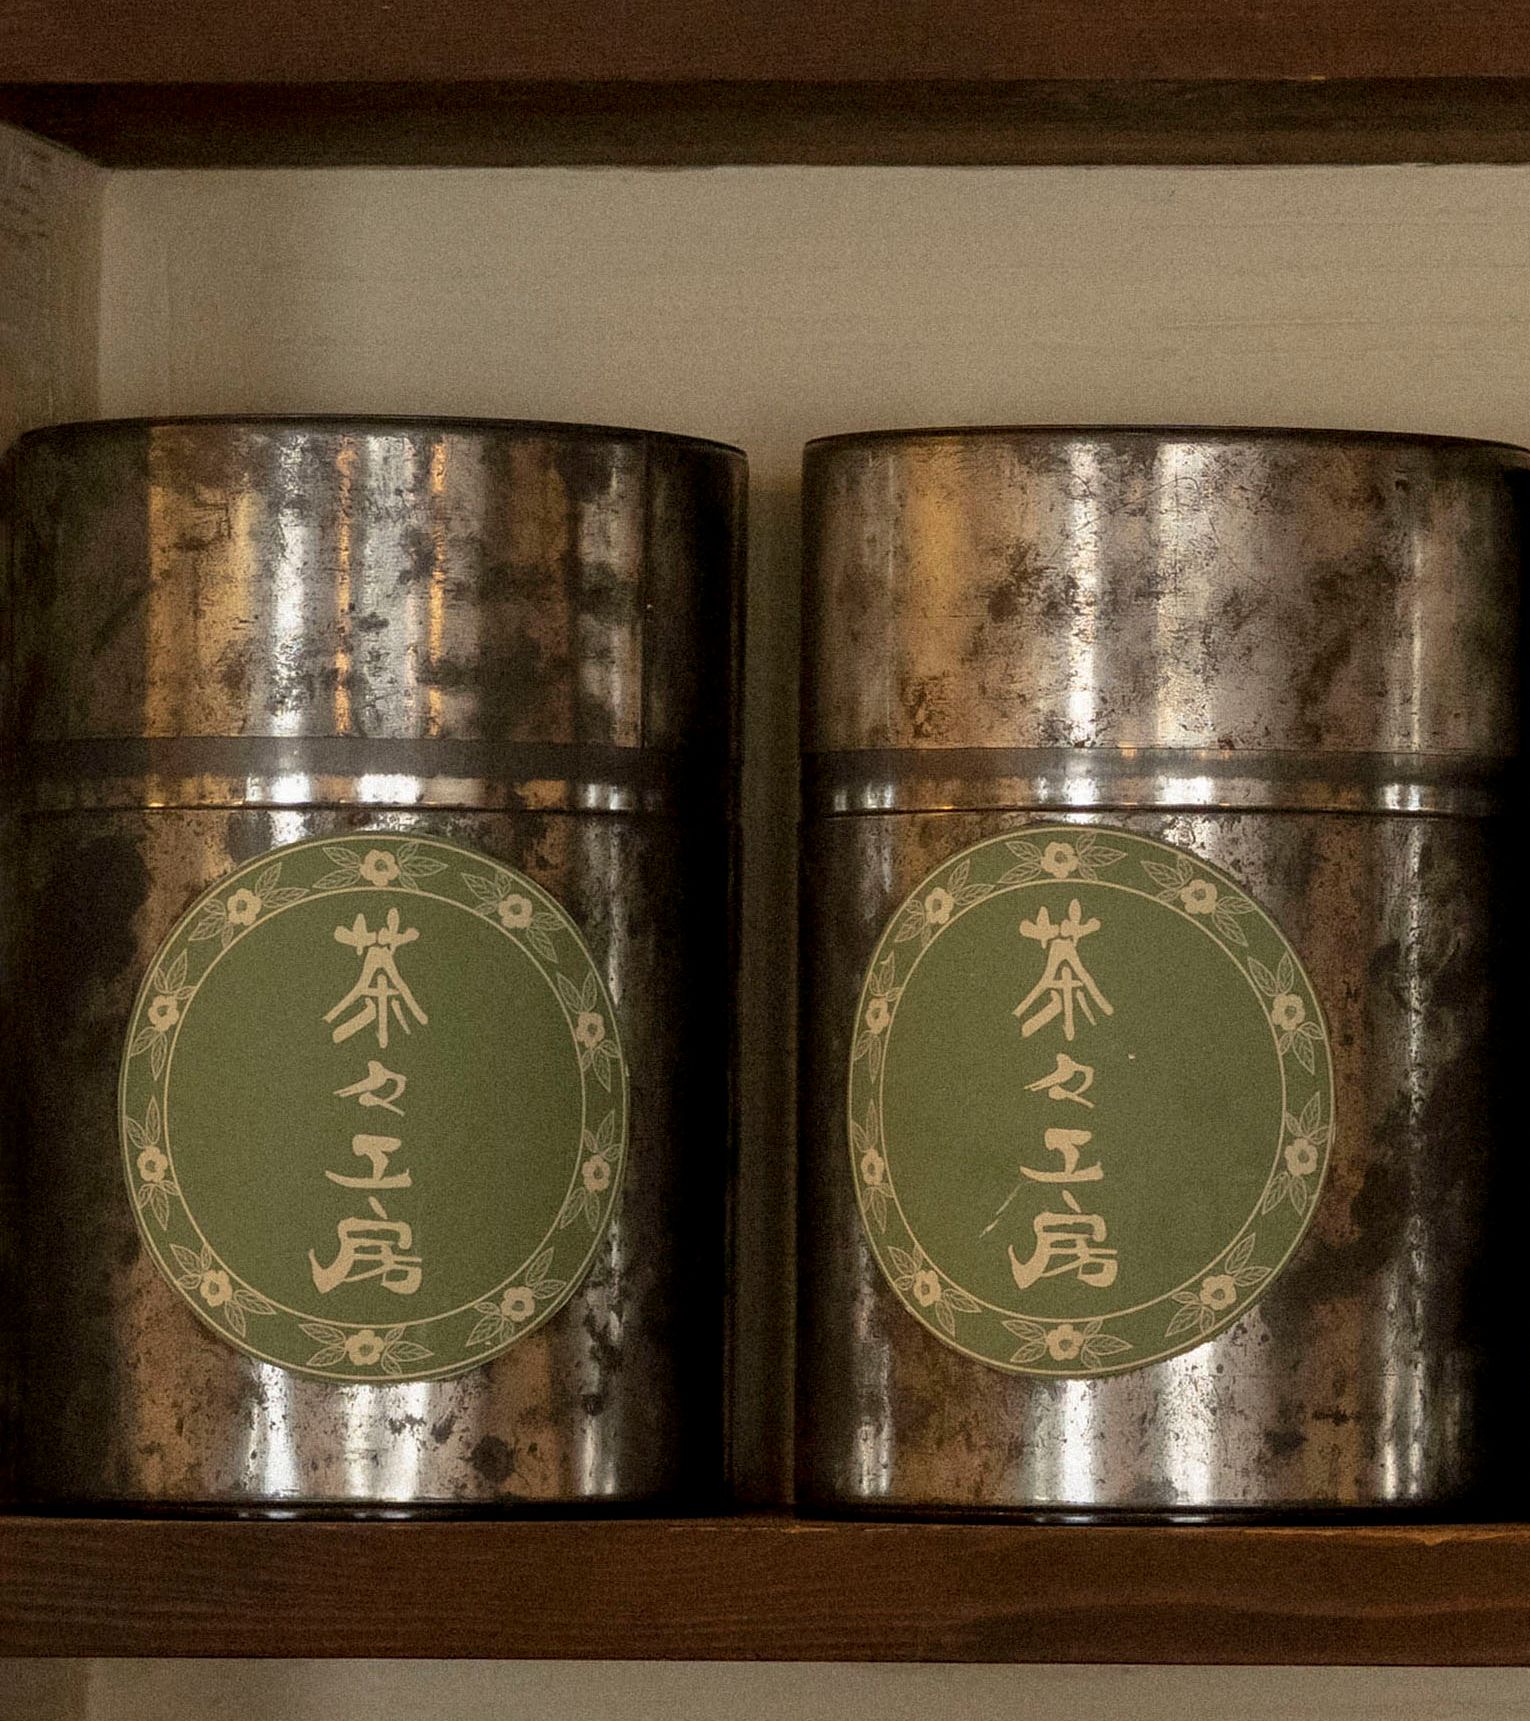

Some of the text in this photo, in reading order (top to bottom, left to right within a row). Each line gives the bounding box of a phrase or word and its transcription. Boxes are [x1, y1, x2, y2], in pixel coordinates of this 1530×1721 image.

[308, 907, 429, 1295] 茶々工房
[1007, 898, 1119, 1290] 茶々工房
